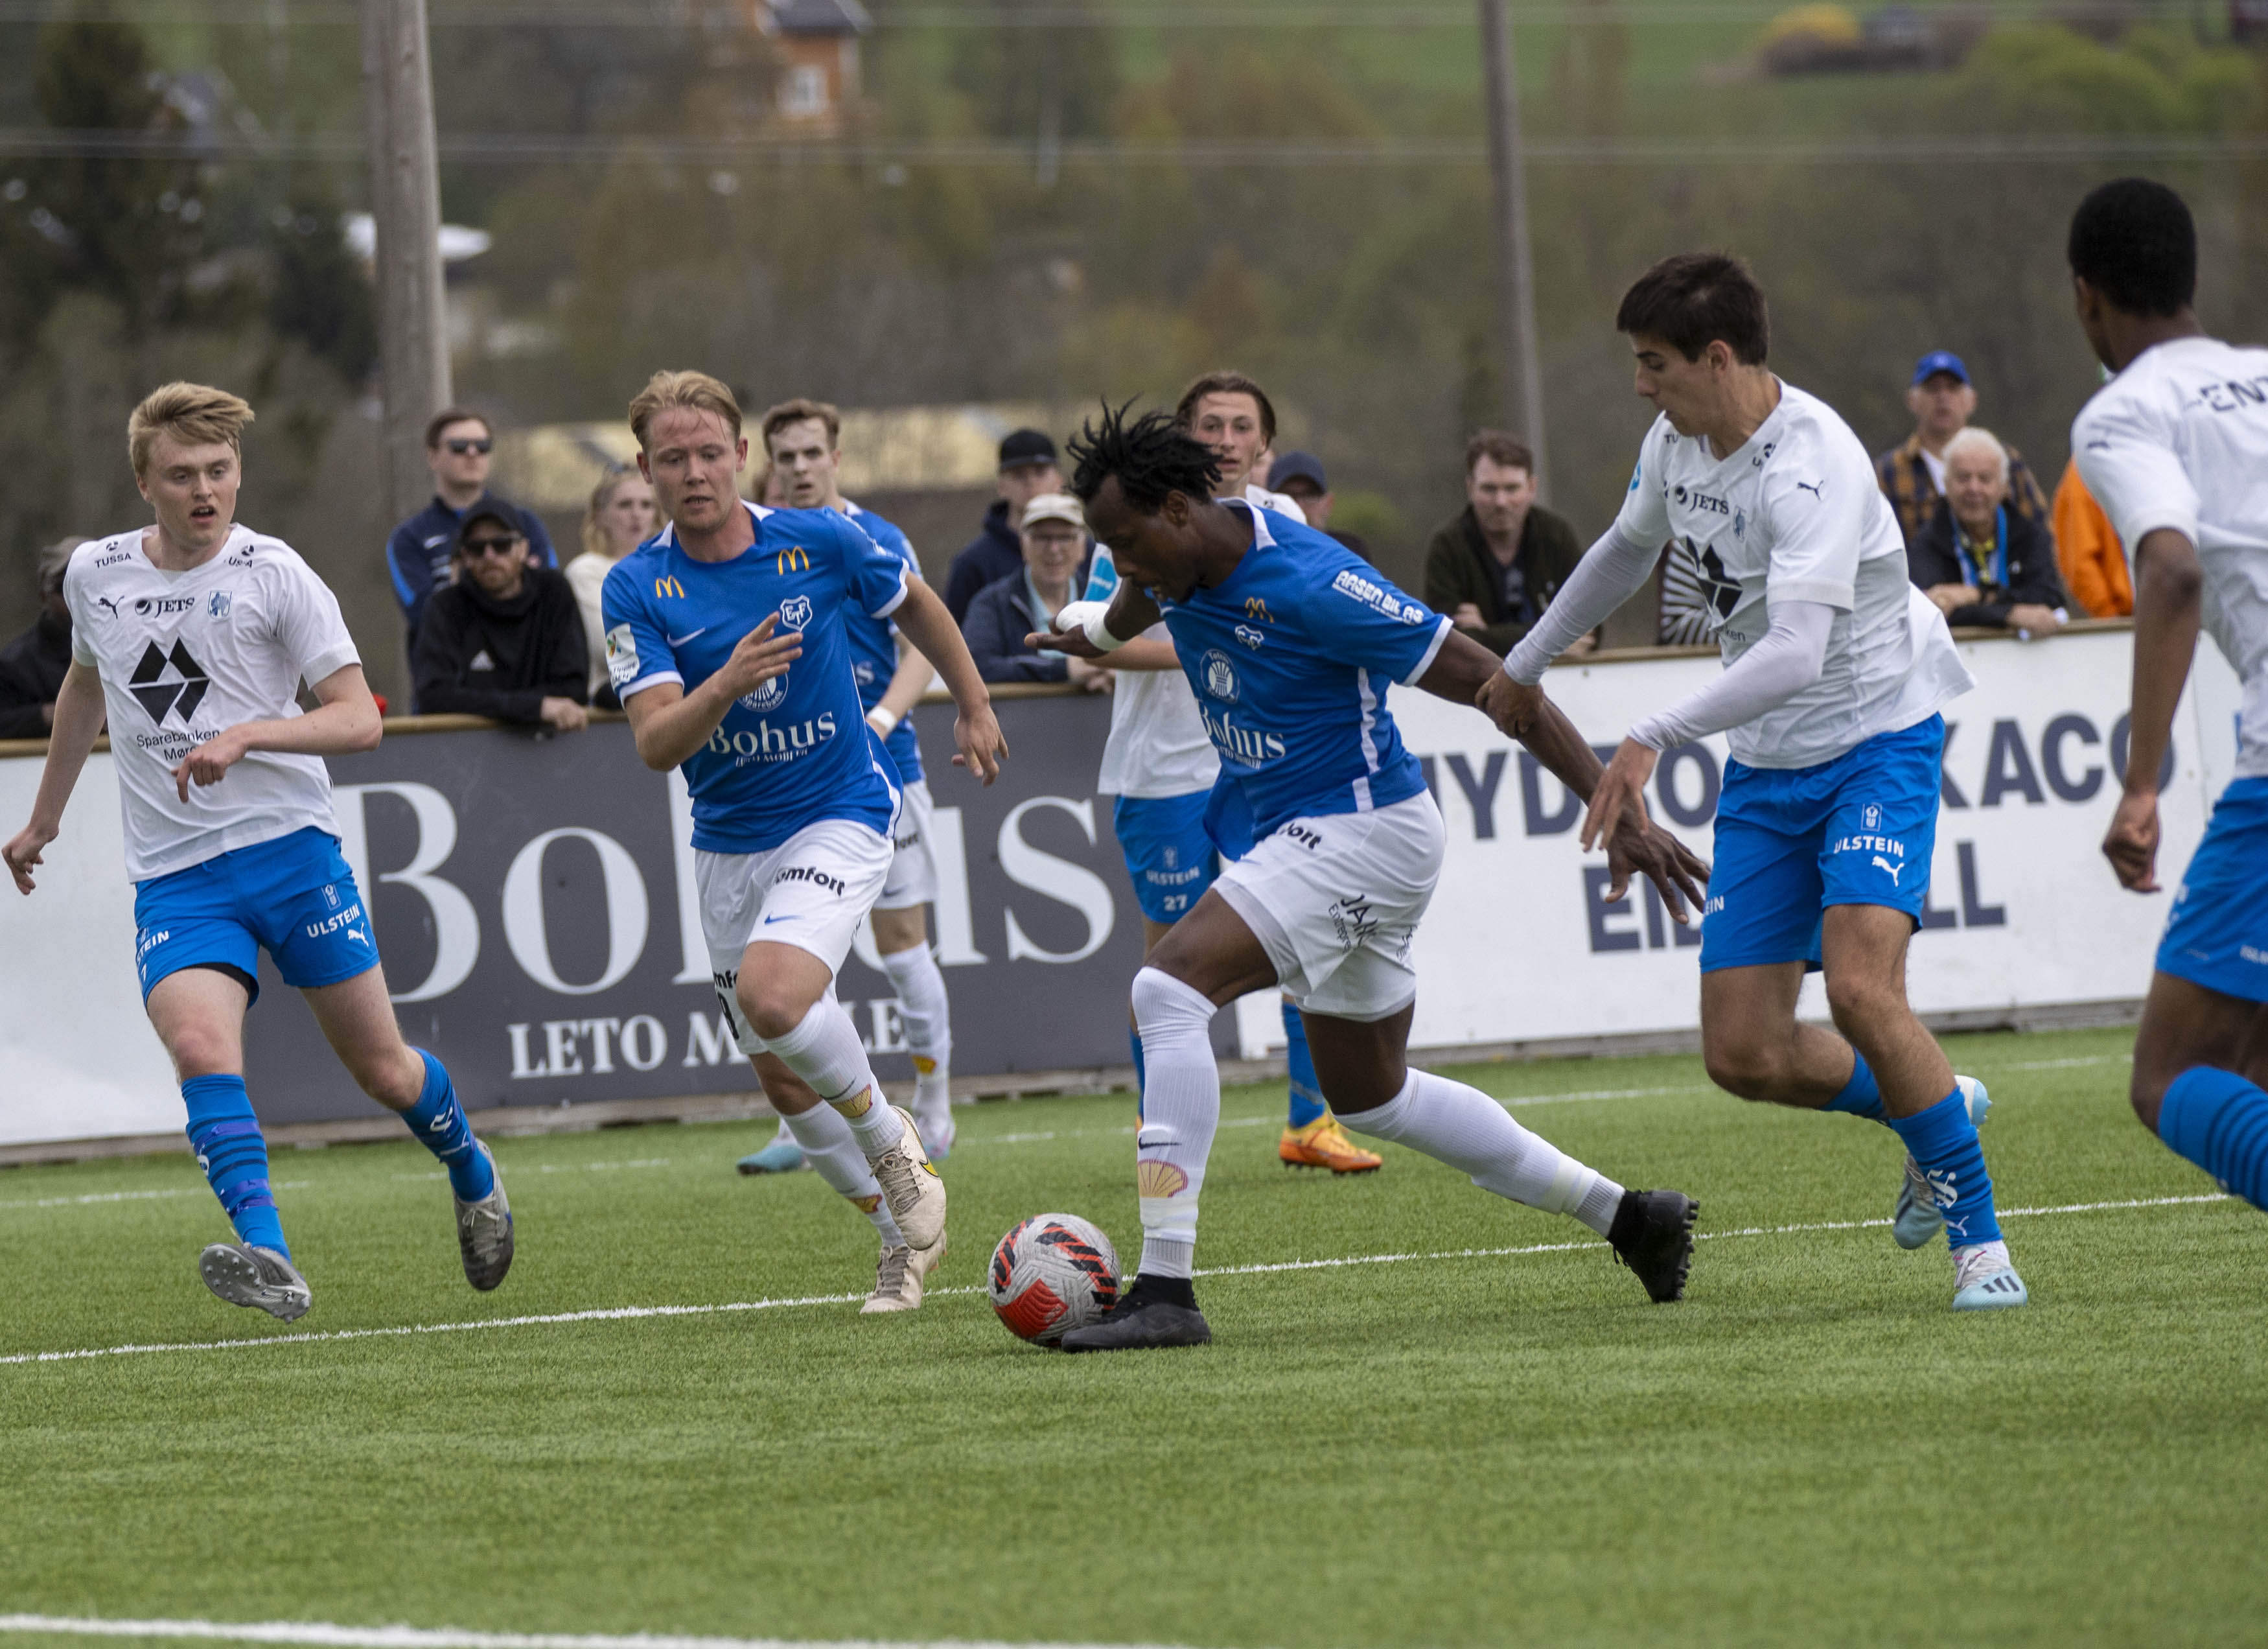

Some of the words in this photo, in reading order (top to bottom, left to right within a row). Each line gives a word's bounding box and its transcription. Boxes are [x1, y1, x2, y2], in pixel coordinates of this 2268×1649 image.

[1690, 493, 1729, 515] JETS
[94, 552, 132, 568] TUSSA
[155, 598, 194, 618] JETS
[137, 729, 220, 749] Sparebanken
[709, 710, 836, 756] Bohus
[1833, 836, 1904, 858] ULSTEIN
[1164, 895, 1187, 911] 27
[307, 903, 360, 938] ULSTEIN
[507, 1014, 668, 1079] LETO
